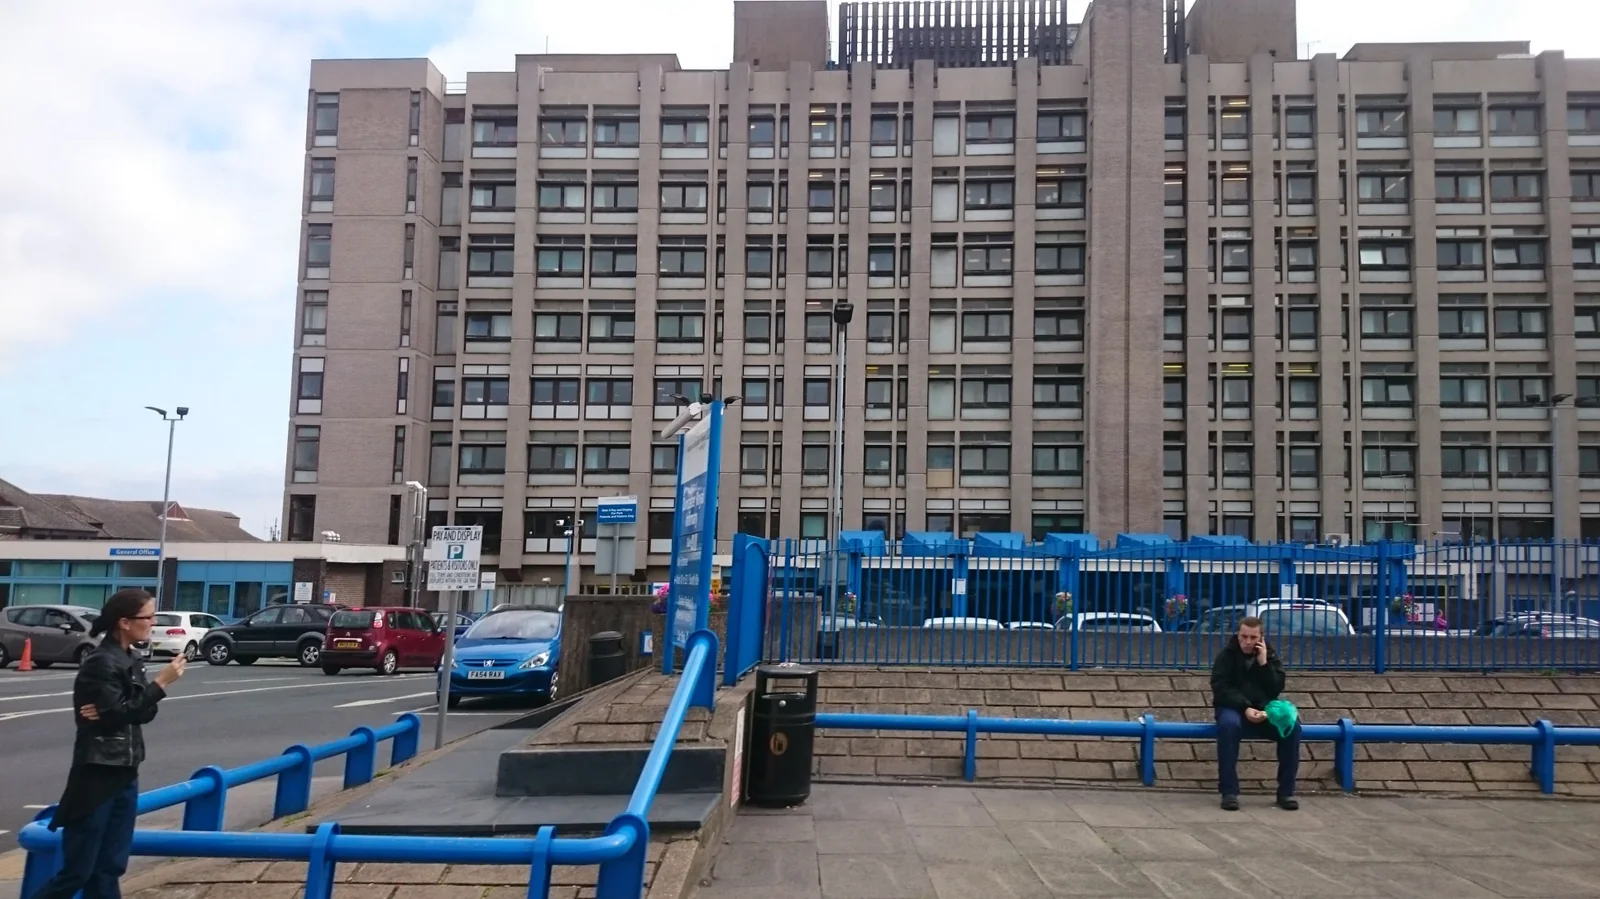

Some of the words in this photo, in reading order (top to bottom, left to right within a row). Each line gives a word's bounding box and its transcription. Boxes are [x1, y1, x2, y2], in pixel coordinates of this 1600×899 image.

[433, 530, 444, 541] PAY
[444, 530, 456, 541] AND
[457, 530, 481, 540] DISPLAY
[450, 545, 462, 559] P
[430, 560, 447, 570] PATIENTS
[451, 560, 467, 570] VISITORS
[468, 560, 478, 570] ONLY
